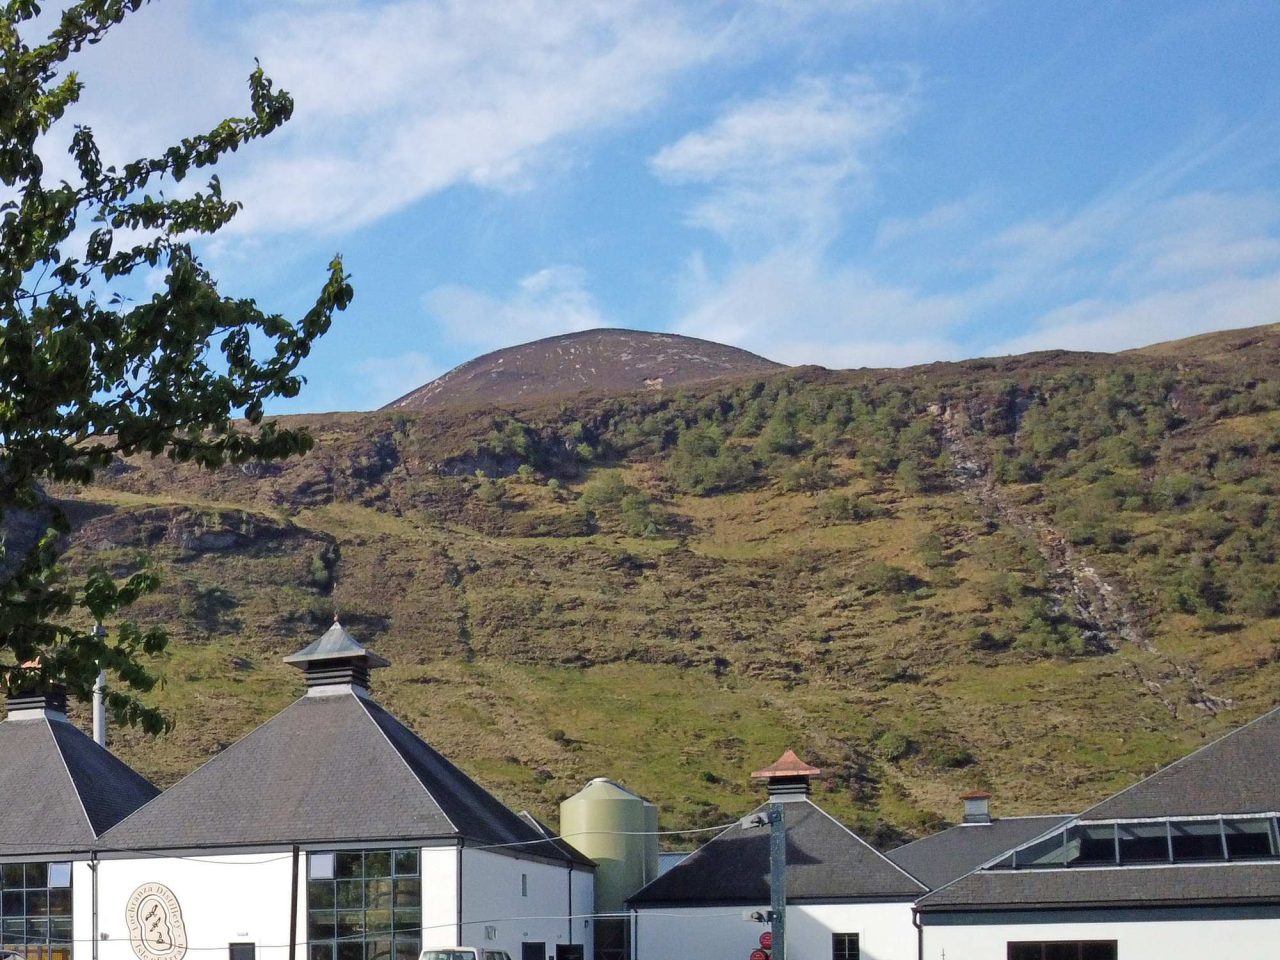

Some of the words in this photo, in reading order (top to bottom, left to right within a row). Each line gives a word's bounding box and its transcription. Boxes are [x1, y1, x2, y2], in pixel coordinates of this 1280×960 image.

[127, 886, 153, 931] Lochranza
[156, 886, 181, 929] Distillery
[135, 944, 149, 959] Isle
